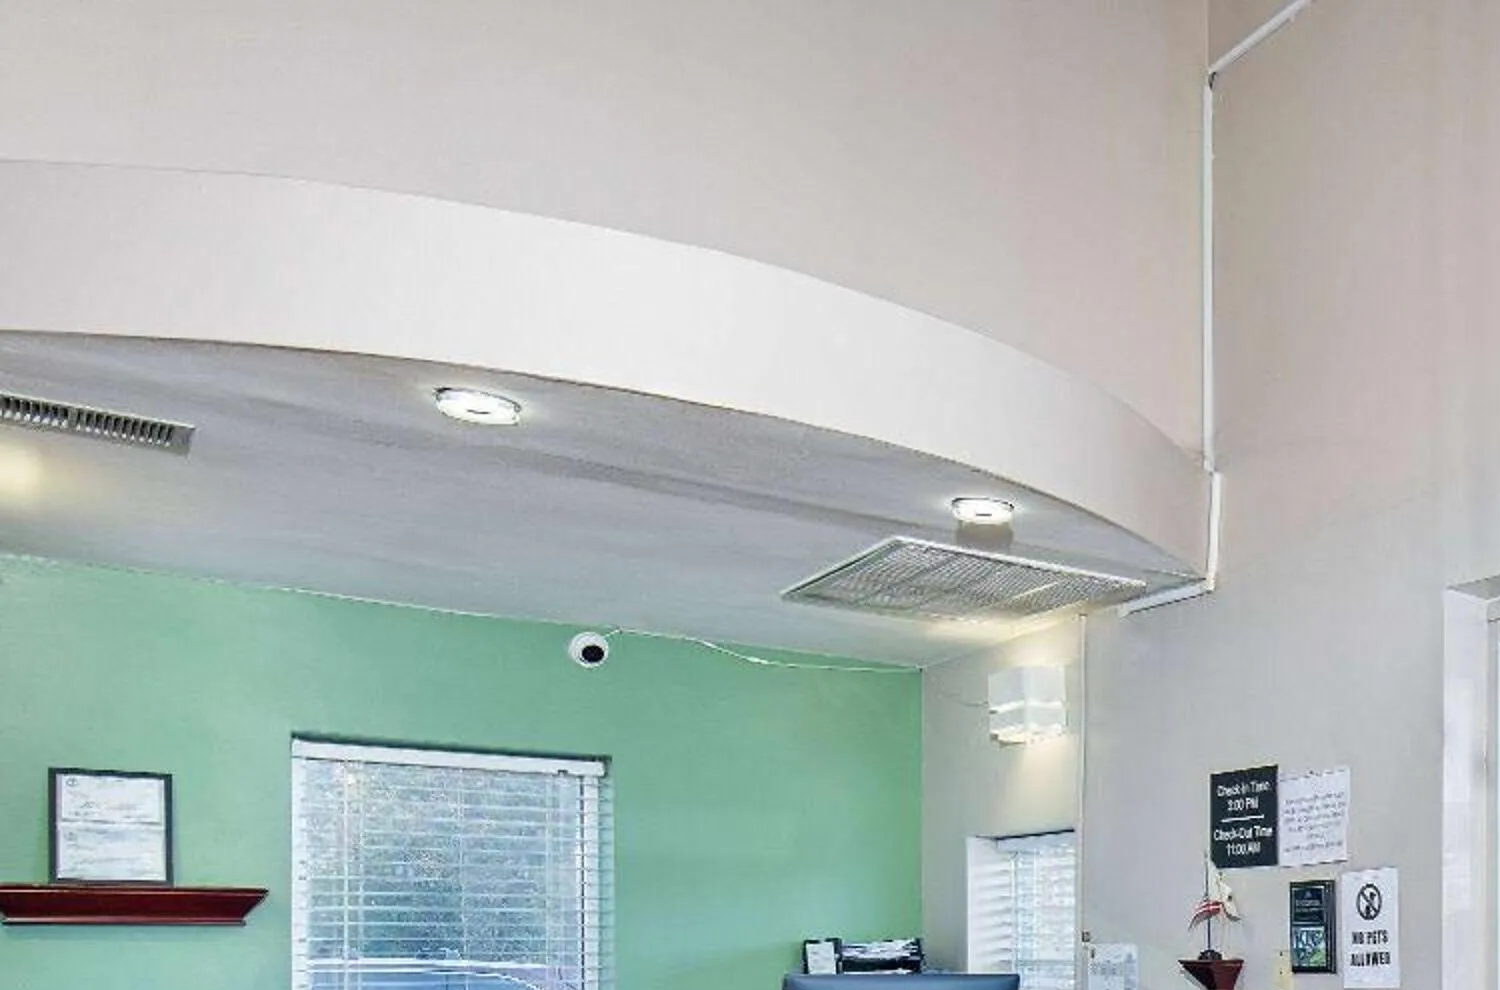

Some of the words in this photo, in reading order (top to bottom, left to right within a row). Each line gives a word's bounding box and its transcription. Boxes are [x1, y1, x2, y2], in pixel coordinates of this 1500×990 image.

[1245, 796, 1259, 810] PM
[1213, 827, 1253, 841] Check-Out
[1226, 842, 1246, 856] 11:00
[1351, 931, 1364, 944] NO
[1365, 929, 1388, 944] PETS
[1350, 951, 1391, 967] ALLOWED
